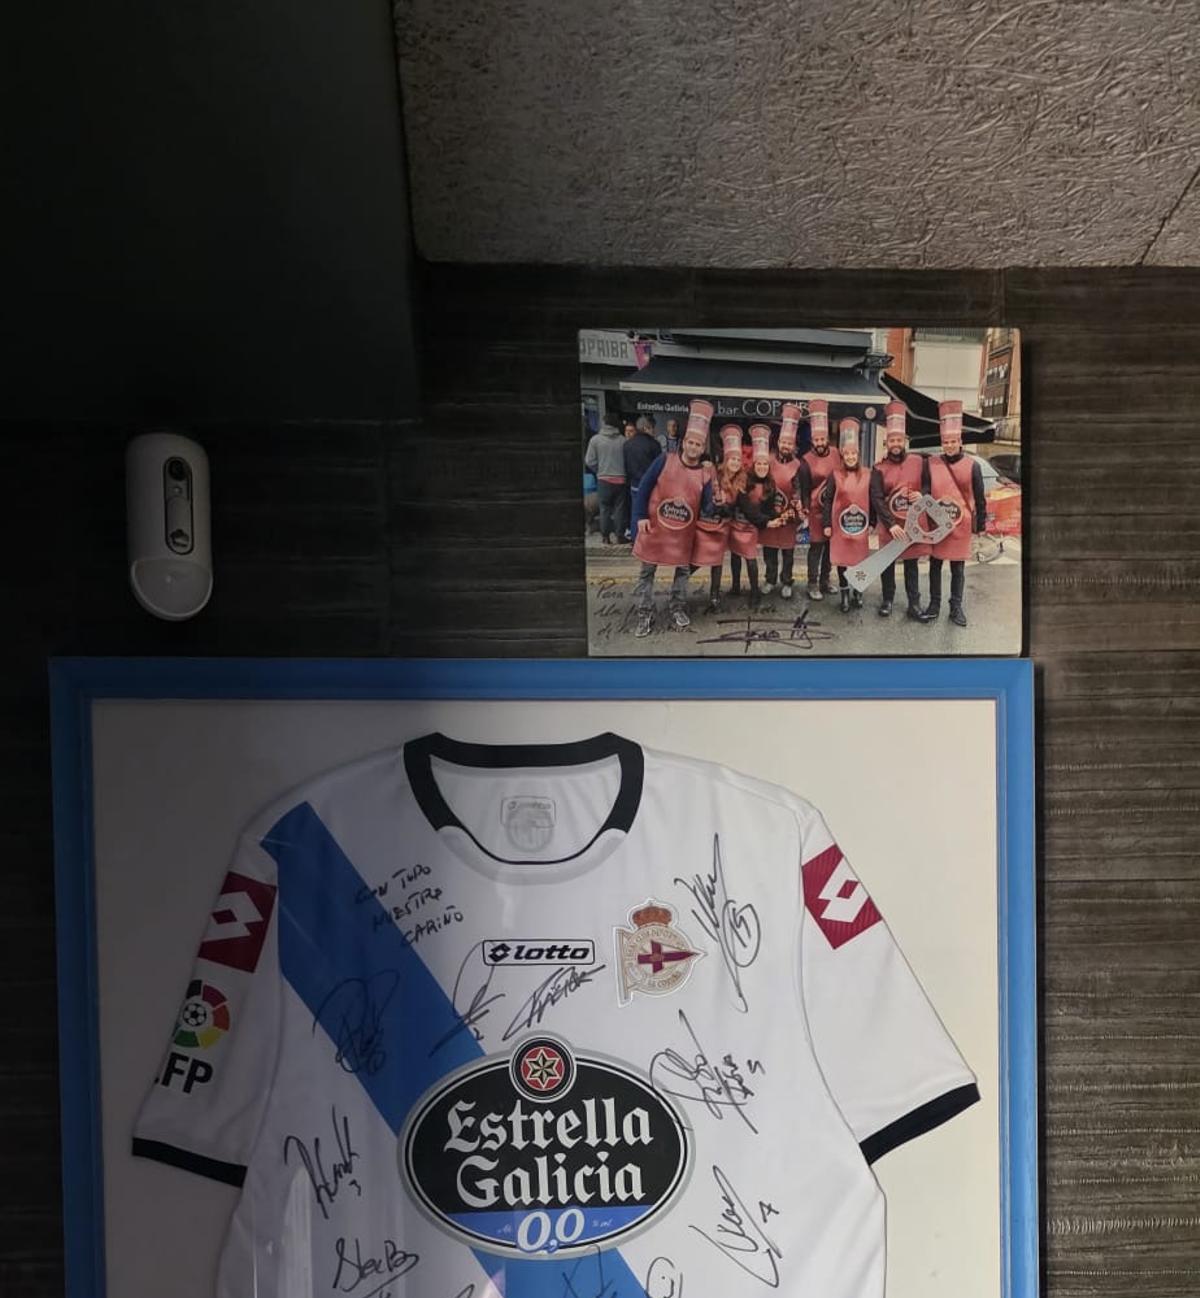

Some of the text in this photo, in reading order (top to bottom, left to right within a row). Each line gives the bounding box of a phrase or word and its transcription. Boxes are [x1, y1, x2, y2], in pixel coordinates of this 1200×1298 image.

[718, 401, 739, 416] bar
[400, 905, 464, 946] CARIÑO
[514, 945, 590, 960] lotto
[154, 1051, 214, 1094] FP
[444, 1097, 654, 1153] Estrella
[456, 1151, 646, 1208] Galicia
[517, 1208, 586, 1252] 0,0
